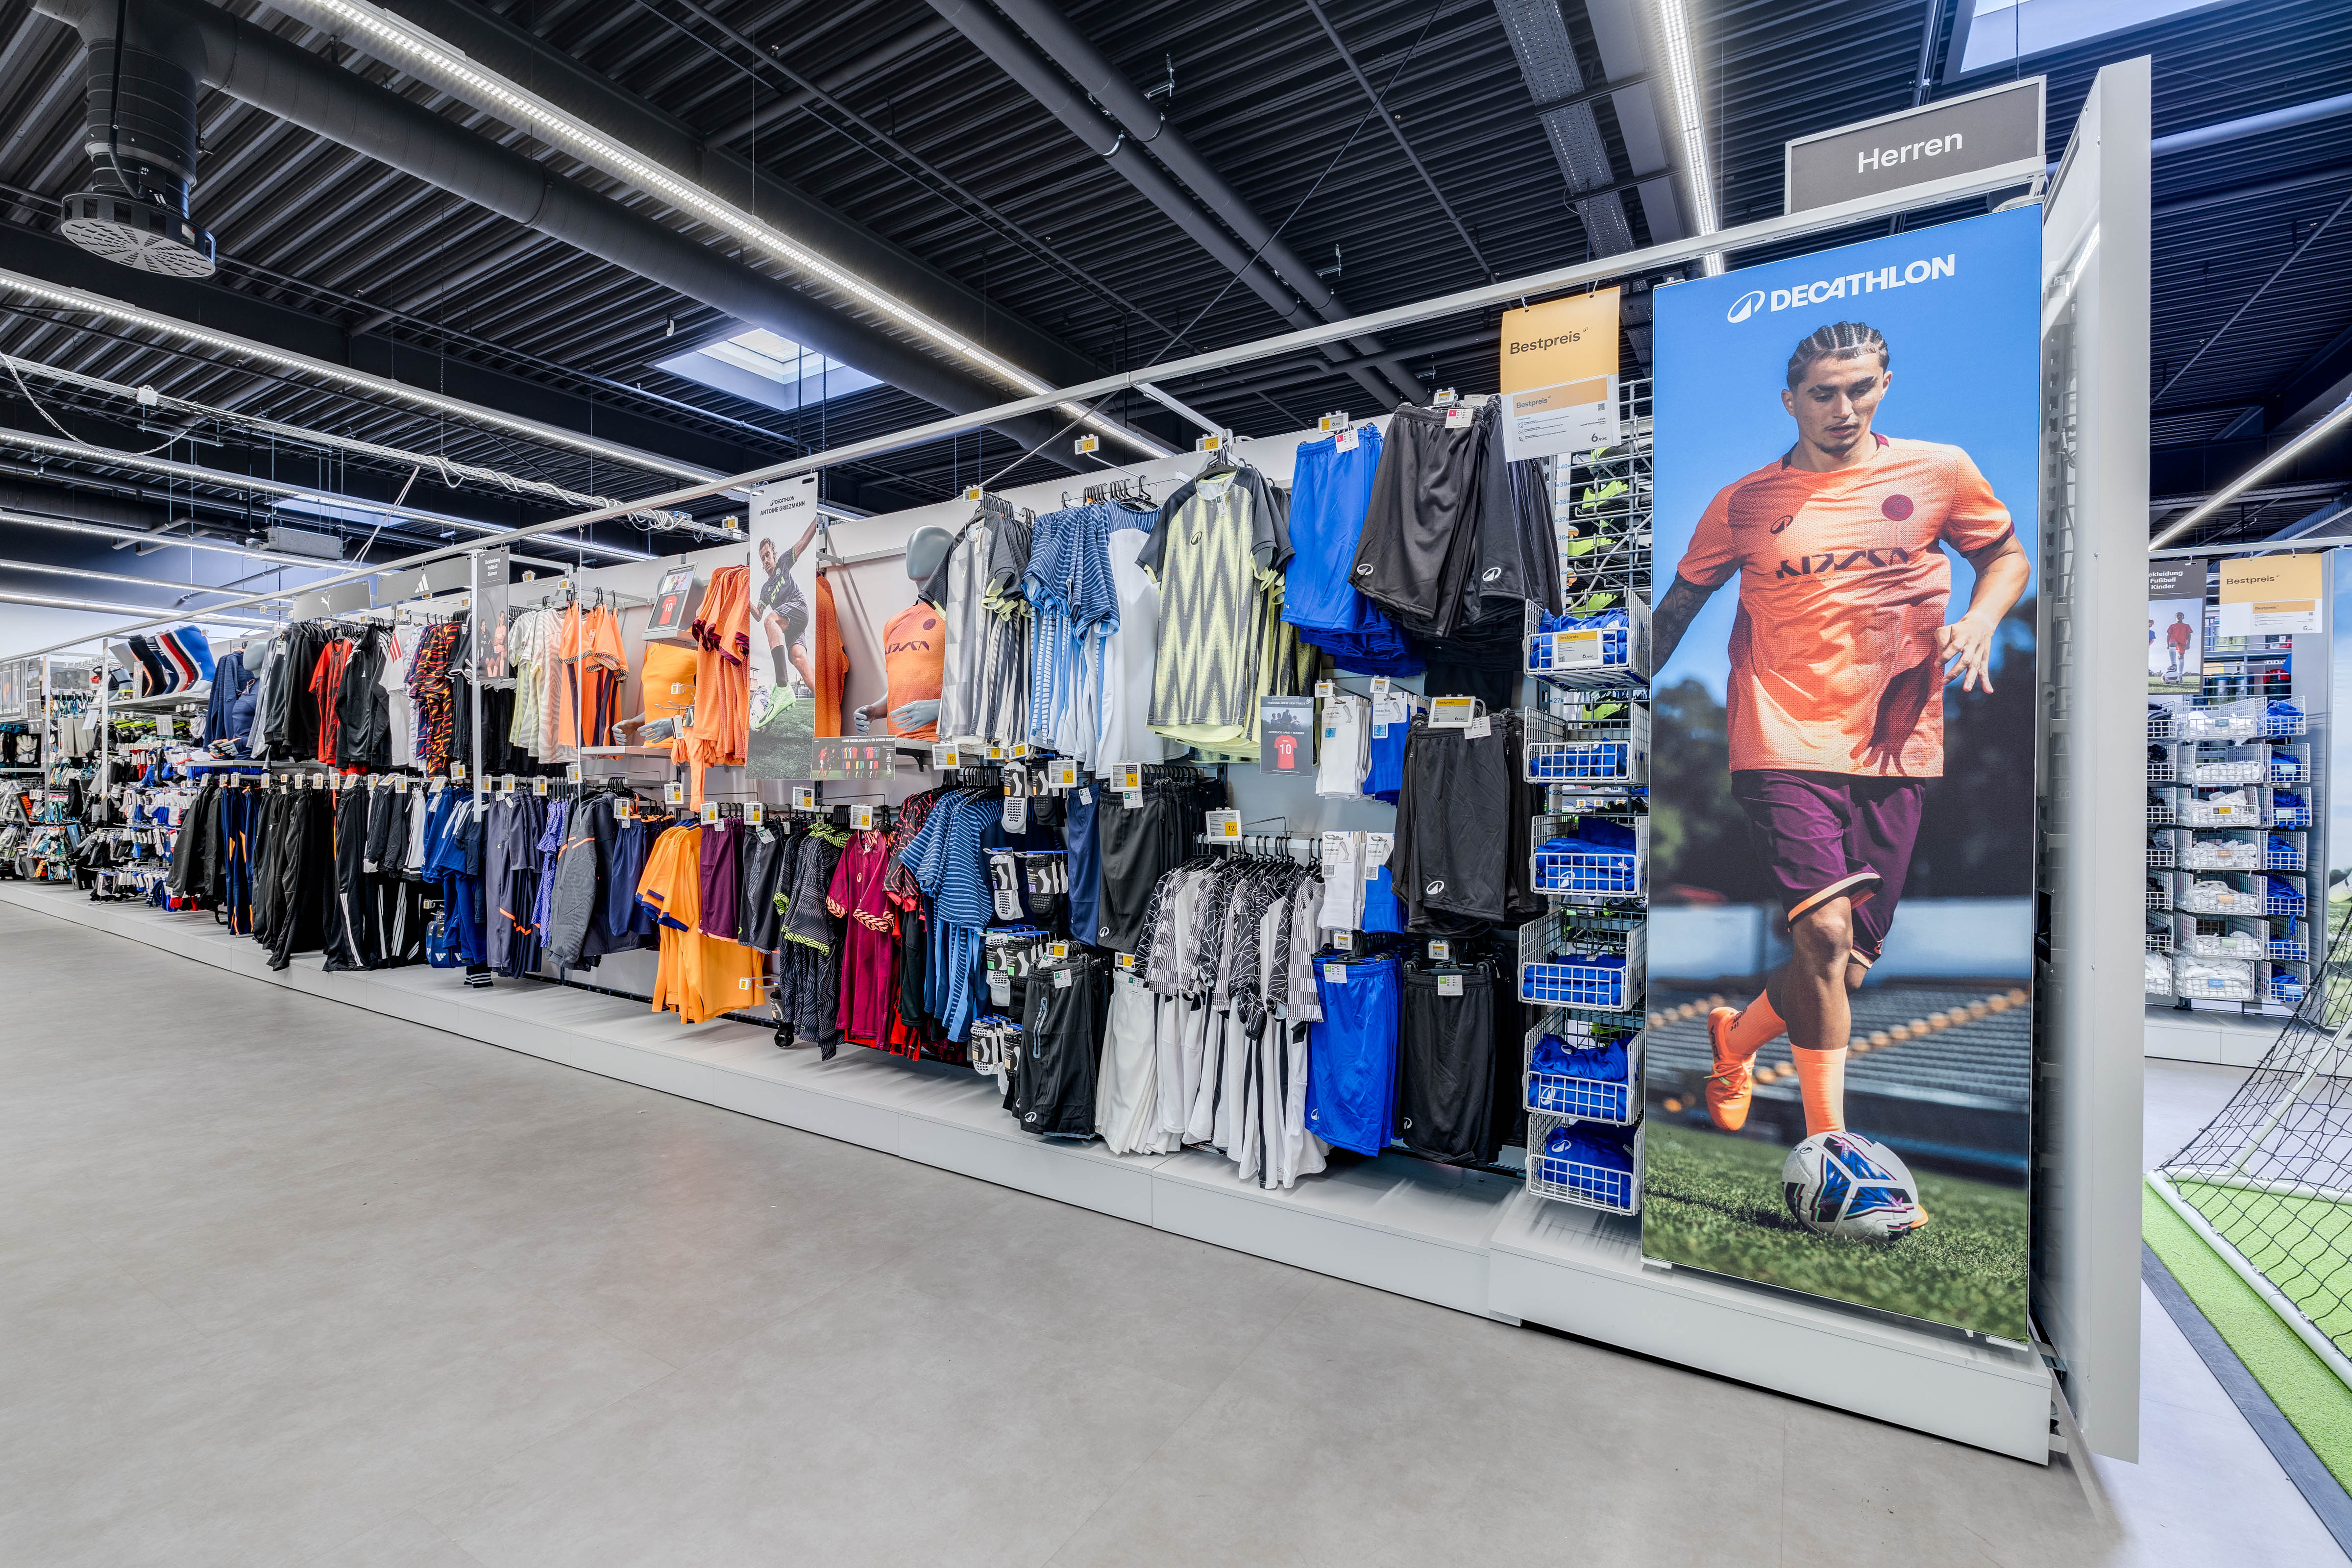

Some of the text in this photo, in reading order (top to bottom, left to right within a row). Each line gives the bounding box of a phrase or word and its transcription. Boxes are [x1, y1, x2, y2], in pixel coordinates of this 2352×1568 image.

[1858, 133, 1962, 173] Herren
[1770, 253, 1955, 312] DECATHLON
[1510, 331, 1580, 354] Bestpreis
[1516, 397, 1547, 409] Bestpreis
[1591, 433, 1607, 442] 6,99€
[775, 495, 795, 505] DECATHLON
[760, 501, 805, 516] ANTOINE GRIEZMANN
[2227, 575, 2275, 585] Bestpreis
[665, 603, 673, 612] 10
[1279, 744, 1292, 755] 10
